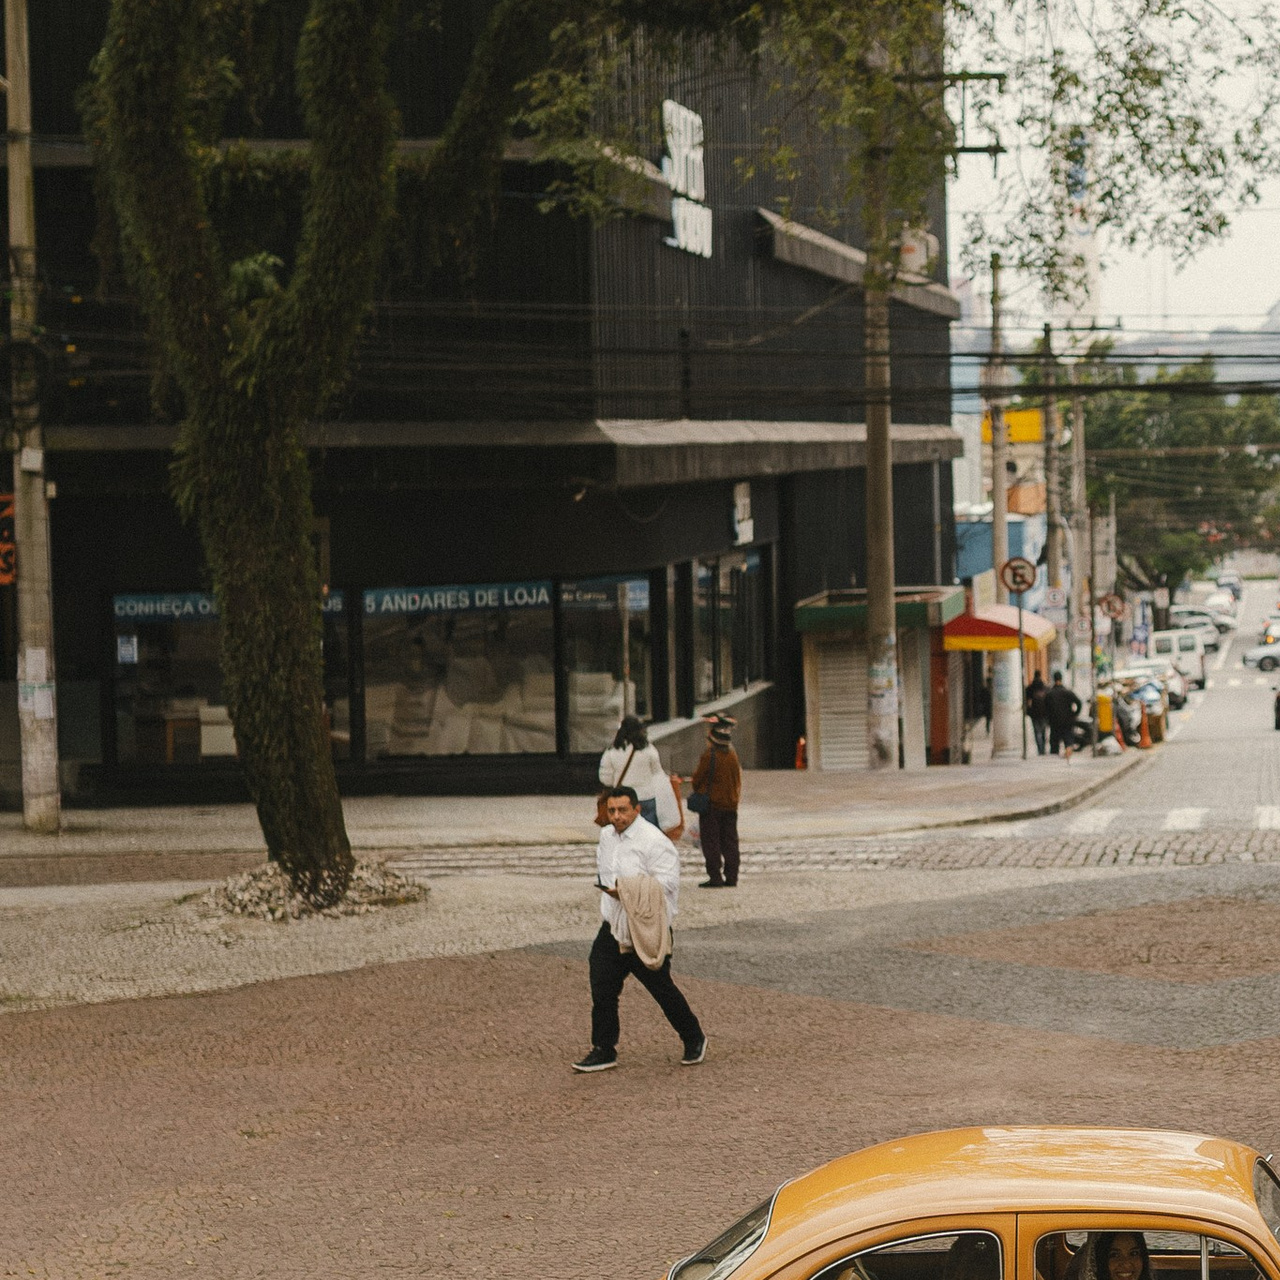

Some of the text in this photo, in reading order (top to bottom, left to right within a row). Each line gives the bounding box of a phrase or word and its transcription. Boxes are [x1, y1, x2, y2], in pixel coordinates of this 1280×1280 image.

[114, 599, 194, 618] CONHEÇA
[365, 587, 550, 613] 5 ANDARES DE LOJA
